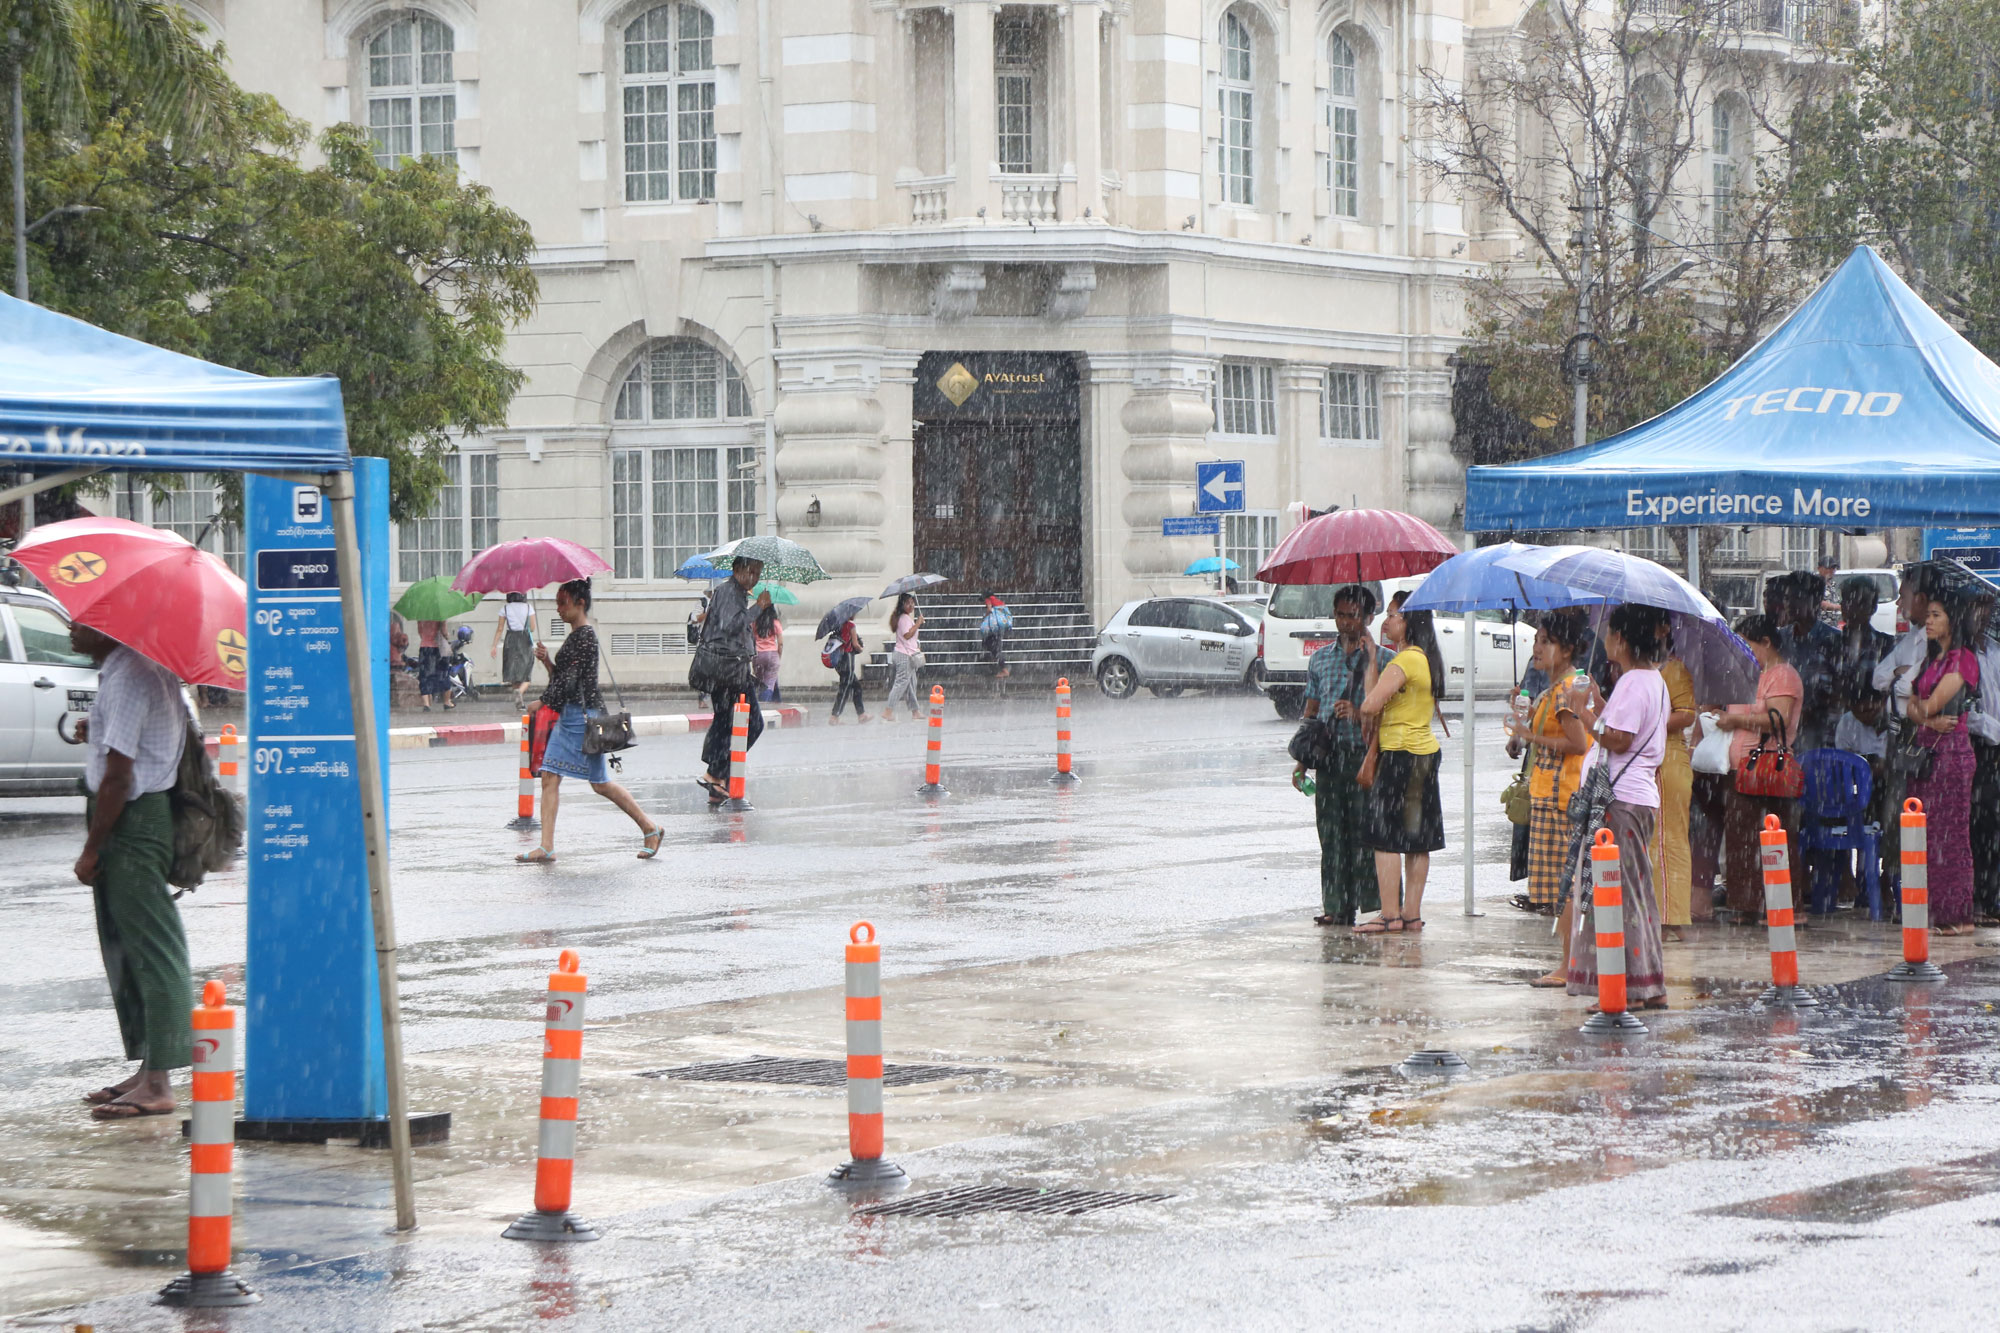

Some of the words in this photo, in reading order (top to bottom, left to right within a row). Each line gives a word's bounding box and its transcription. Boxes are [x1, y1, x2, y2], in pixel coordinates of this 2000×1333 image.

[984, 372, 1046, 383] AYAtrust
[1723, 386, 1903, 421] TECNO
[1626, 487, 1783, 523] Experience
[1793, 487, 1871, 517] More
